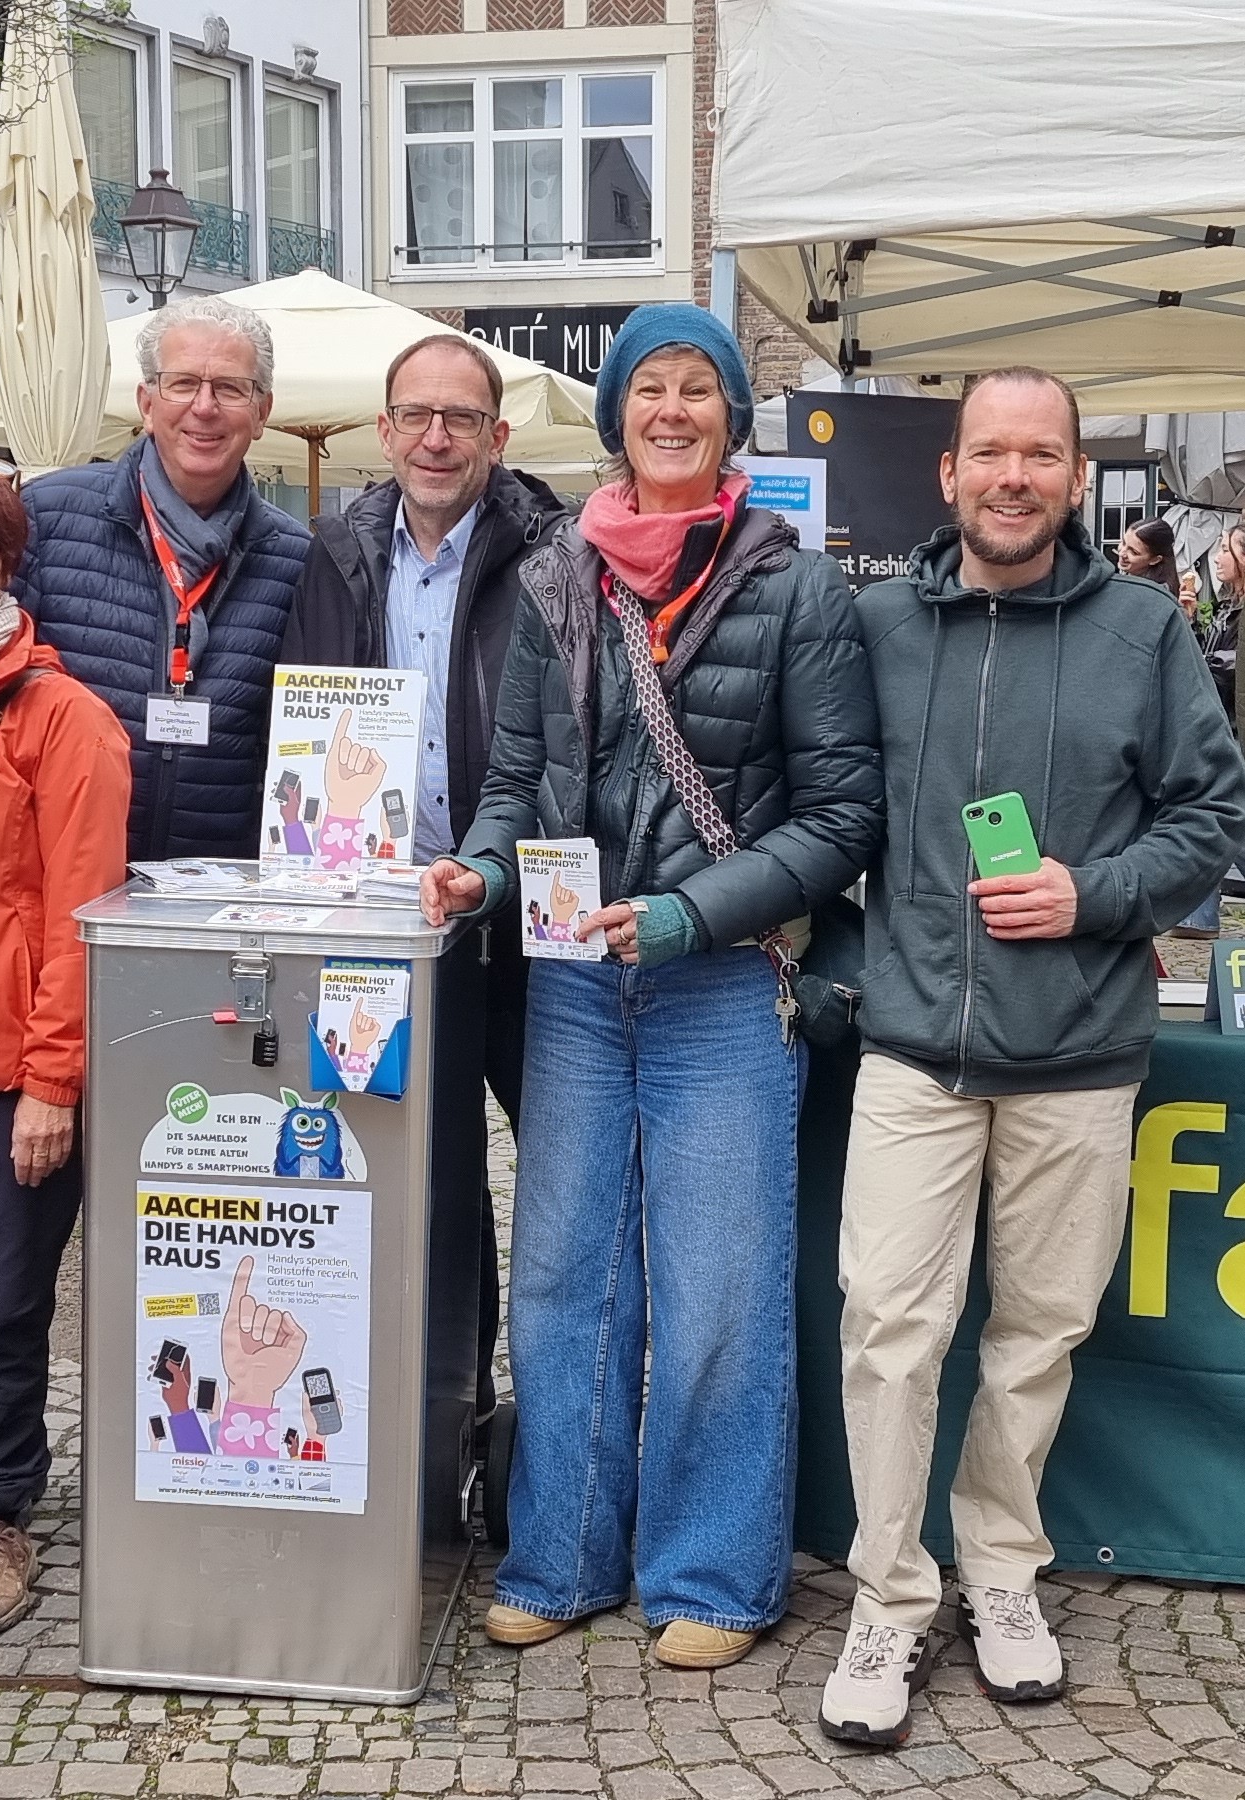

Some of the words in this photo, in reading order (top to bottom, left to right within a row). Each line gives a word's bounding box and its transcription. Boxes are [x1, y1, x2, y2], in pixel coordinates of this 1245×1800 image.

[564, 324, 624, 374] MUN
[860, 554, 911, 576] Fashio
[285, 674, 356, 690] AACHEN
[360, 677, 405, 692] HOLT
[284, 690, 312, 704] DIE
[316, 691, 389, 706] HANDYS
[283, 705, 330, 720] RAUS
[524, 848, 562, 858] AACHEN
[564, 852, 589, 860] HOLT
[541, 858, 581, 869] HANDYS
[524, 866, 550, 875] RAUS
[326, 974, 367, 984] AACHEN
[369, 977, 395, 986] HOLT
[324, 984, 341, 992] DIE
[344, 984, 386, 994] HANDYS
[324, 993, 352, 1002] RAUS
[216, 1114, 236, 1124] ICH
[240, 1115, 261, 1125] BIN
[166, 1132, 184, 1142] DIE
[187, 1133, 248, 1144] SAMMELBOX
[166, 1146, 184, 1156] FÜR
[187, 1148, 216, 1157] DEINE
[220, 1149, 248, 1158] ALTEN
[144, 1160, 184, 1170] HANDYS
[197, 1162, 271, 1174] SMARTPHONES
[144, 1195, 260, 1221] AACHEN
[267, 1202, 340, 1225] HOLT
[144, 1220, 190, 1242] DIE
[197, 1223, 316, 1249] HANDYS
[144, 1246, 221, 1269] RAUS
[268, 1254, 304, 1266] Handys
[306, 1257, 350, 1268] spenden,
[268, 1266, 315, 1276] Rohstoffe
[266, 1277, 295, 1287] Gutes
[297, 1279, 314, 1288] tun
[172, 1456, 204, 1467] missio
